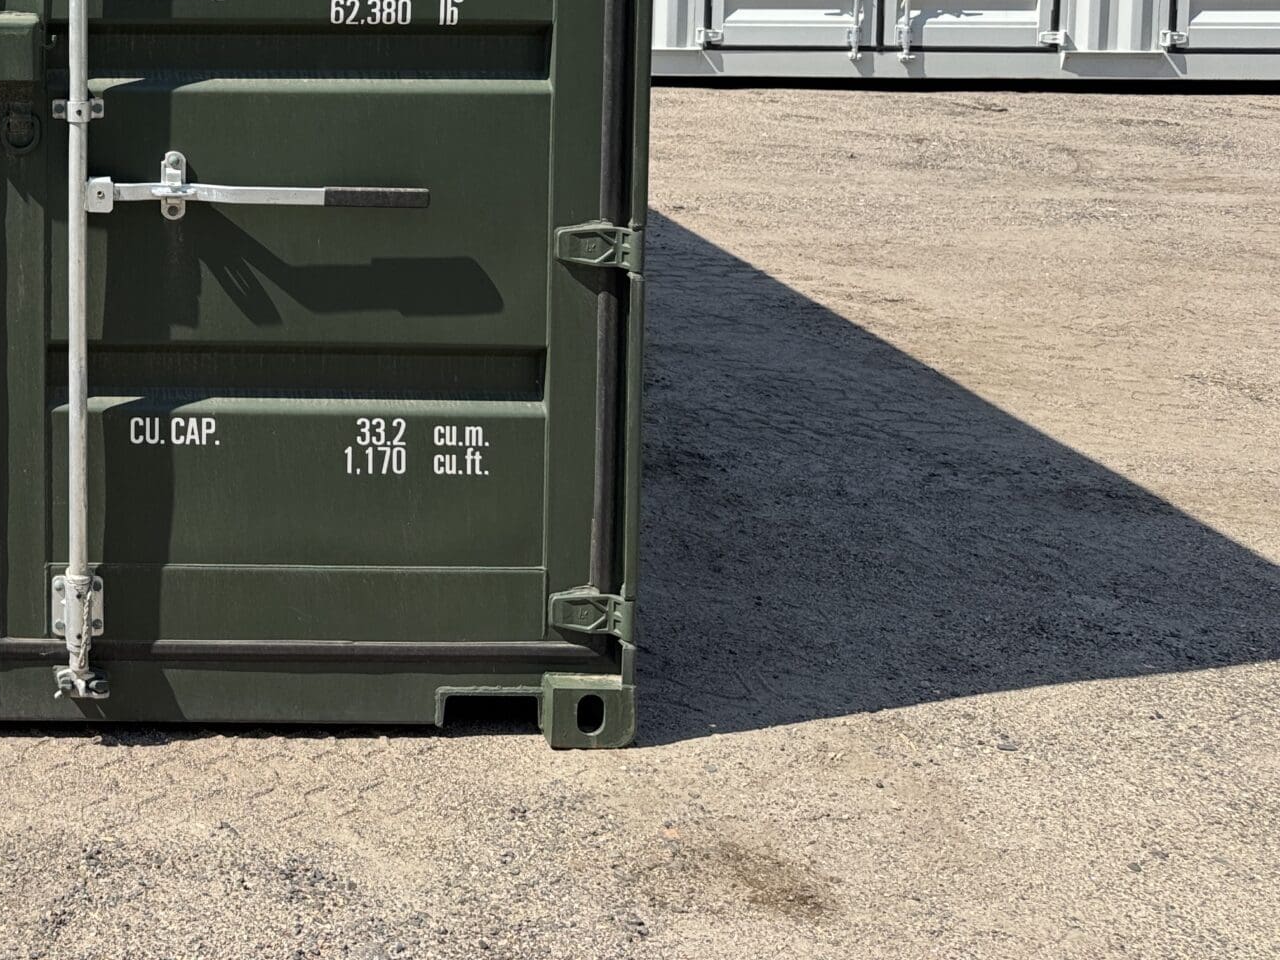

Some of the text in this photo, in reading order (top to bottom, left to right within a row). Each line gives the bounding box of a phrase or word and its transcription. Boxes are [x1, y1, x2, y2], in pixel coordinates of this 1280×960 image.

[130, 418, 489, 446] CU. CAP. 33.2 cu.m.
[344, 446, 489, 475] 1,170 cu.ft.
